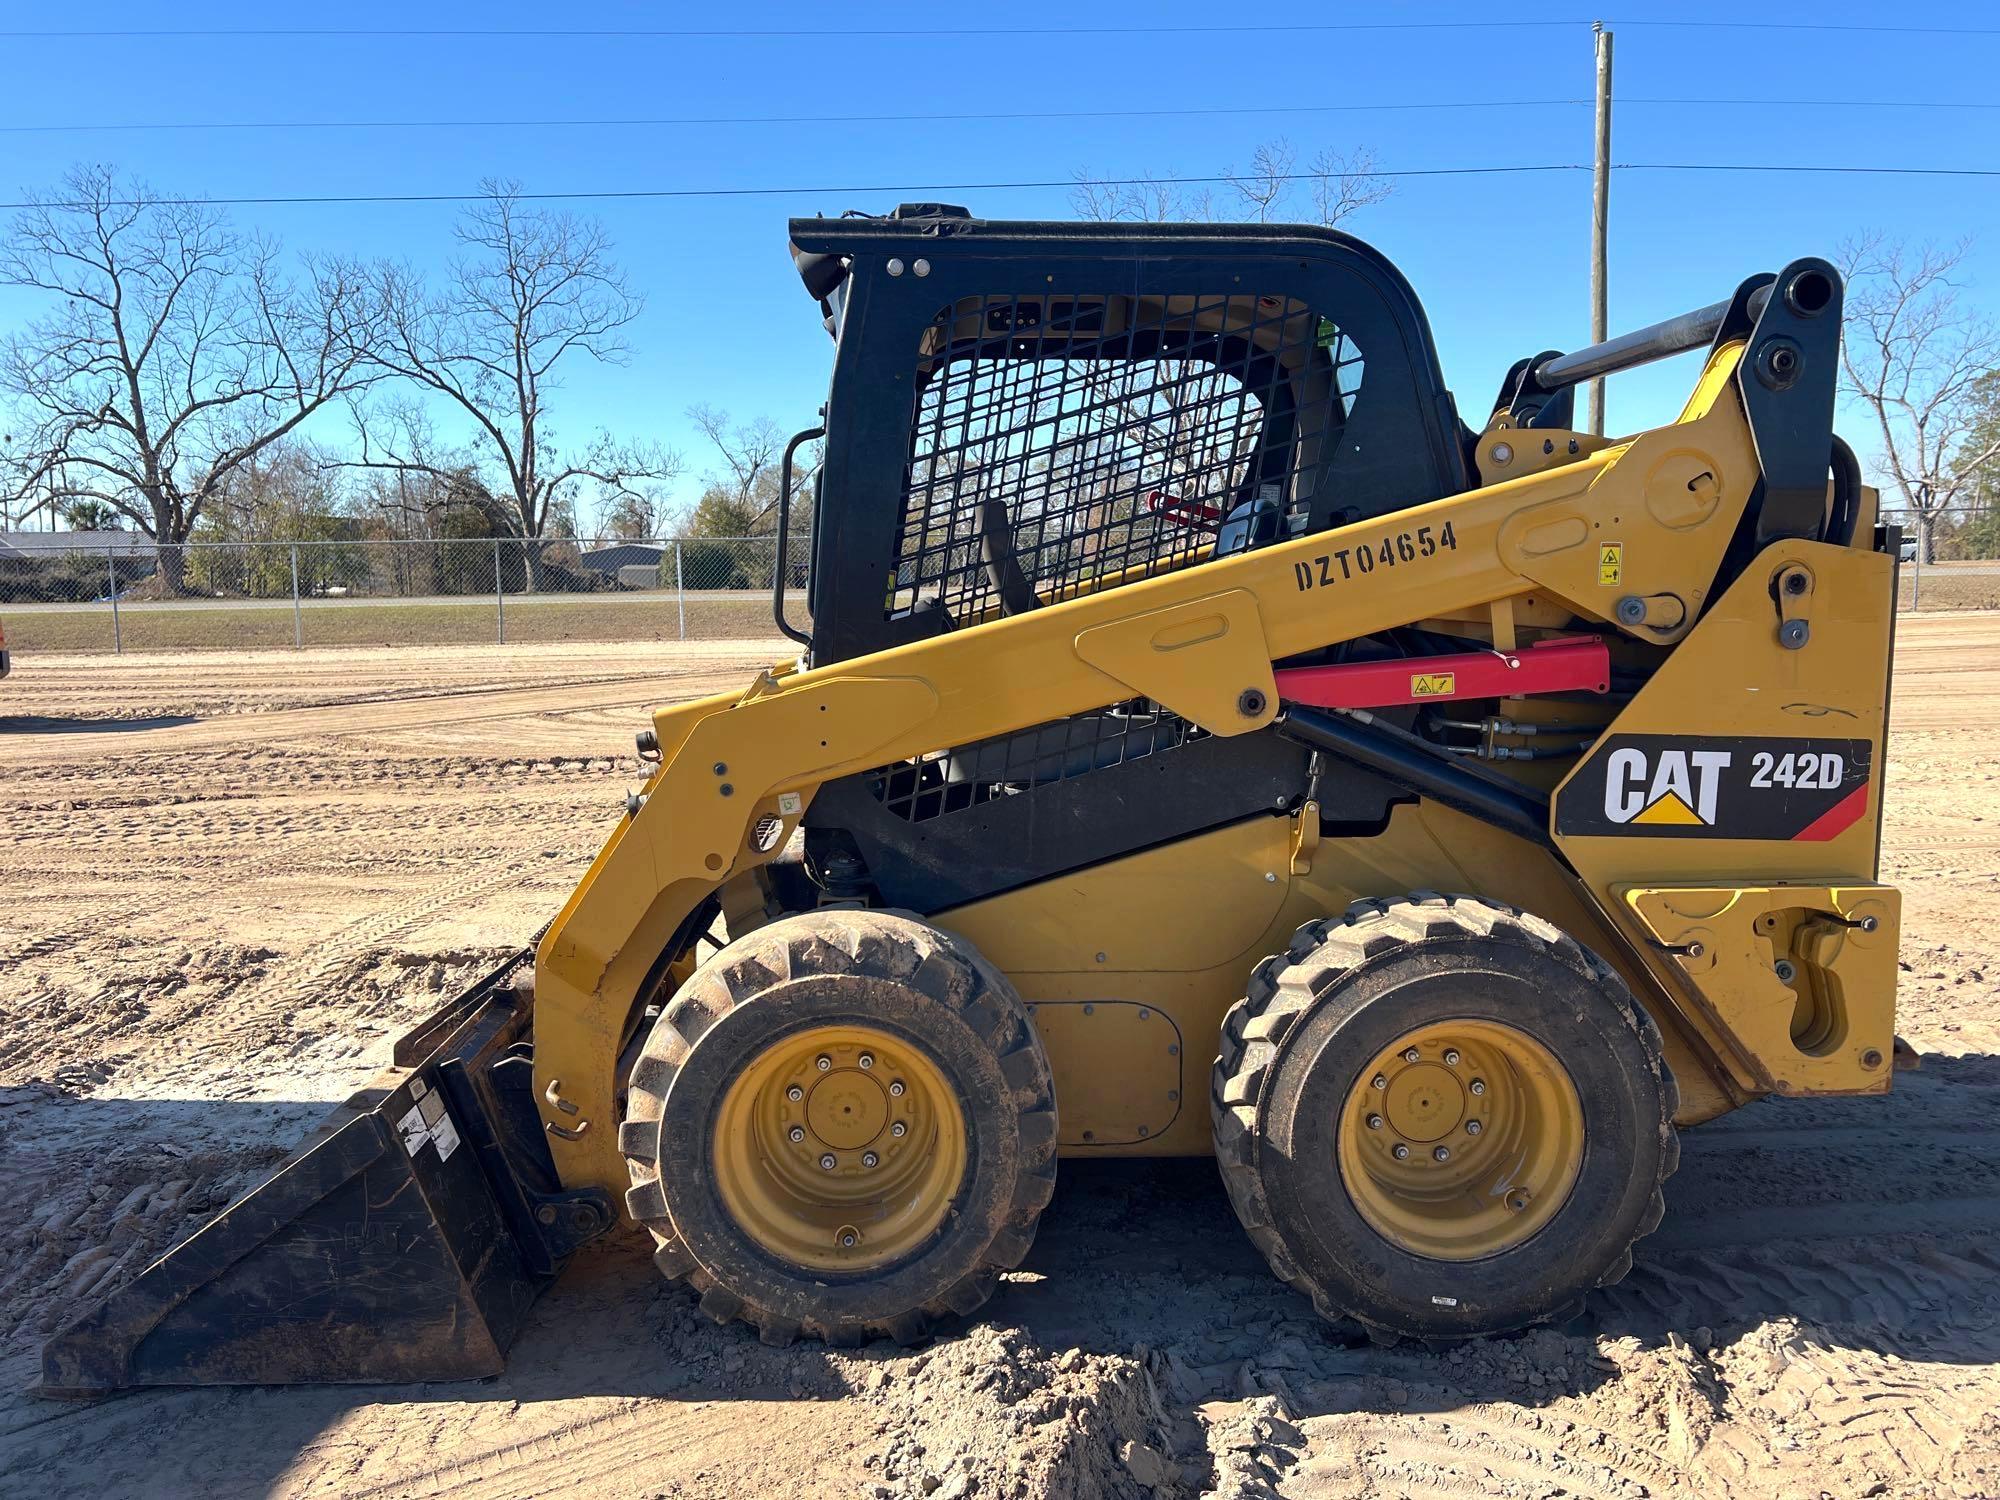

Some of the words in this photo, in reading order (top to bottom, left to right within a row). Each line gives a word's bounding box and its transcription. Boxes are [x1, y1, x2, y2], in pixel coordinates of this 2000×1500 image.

[1295, 521, 1457, 592] DZT04654
[1604, 748, 1732, 826] CAT
[1750, 751, 1844, 790] 242D
